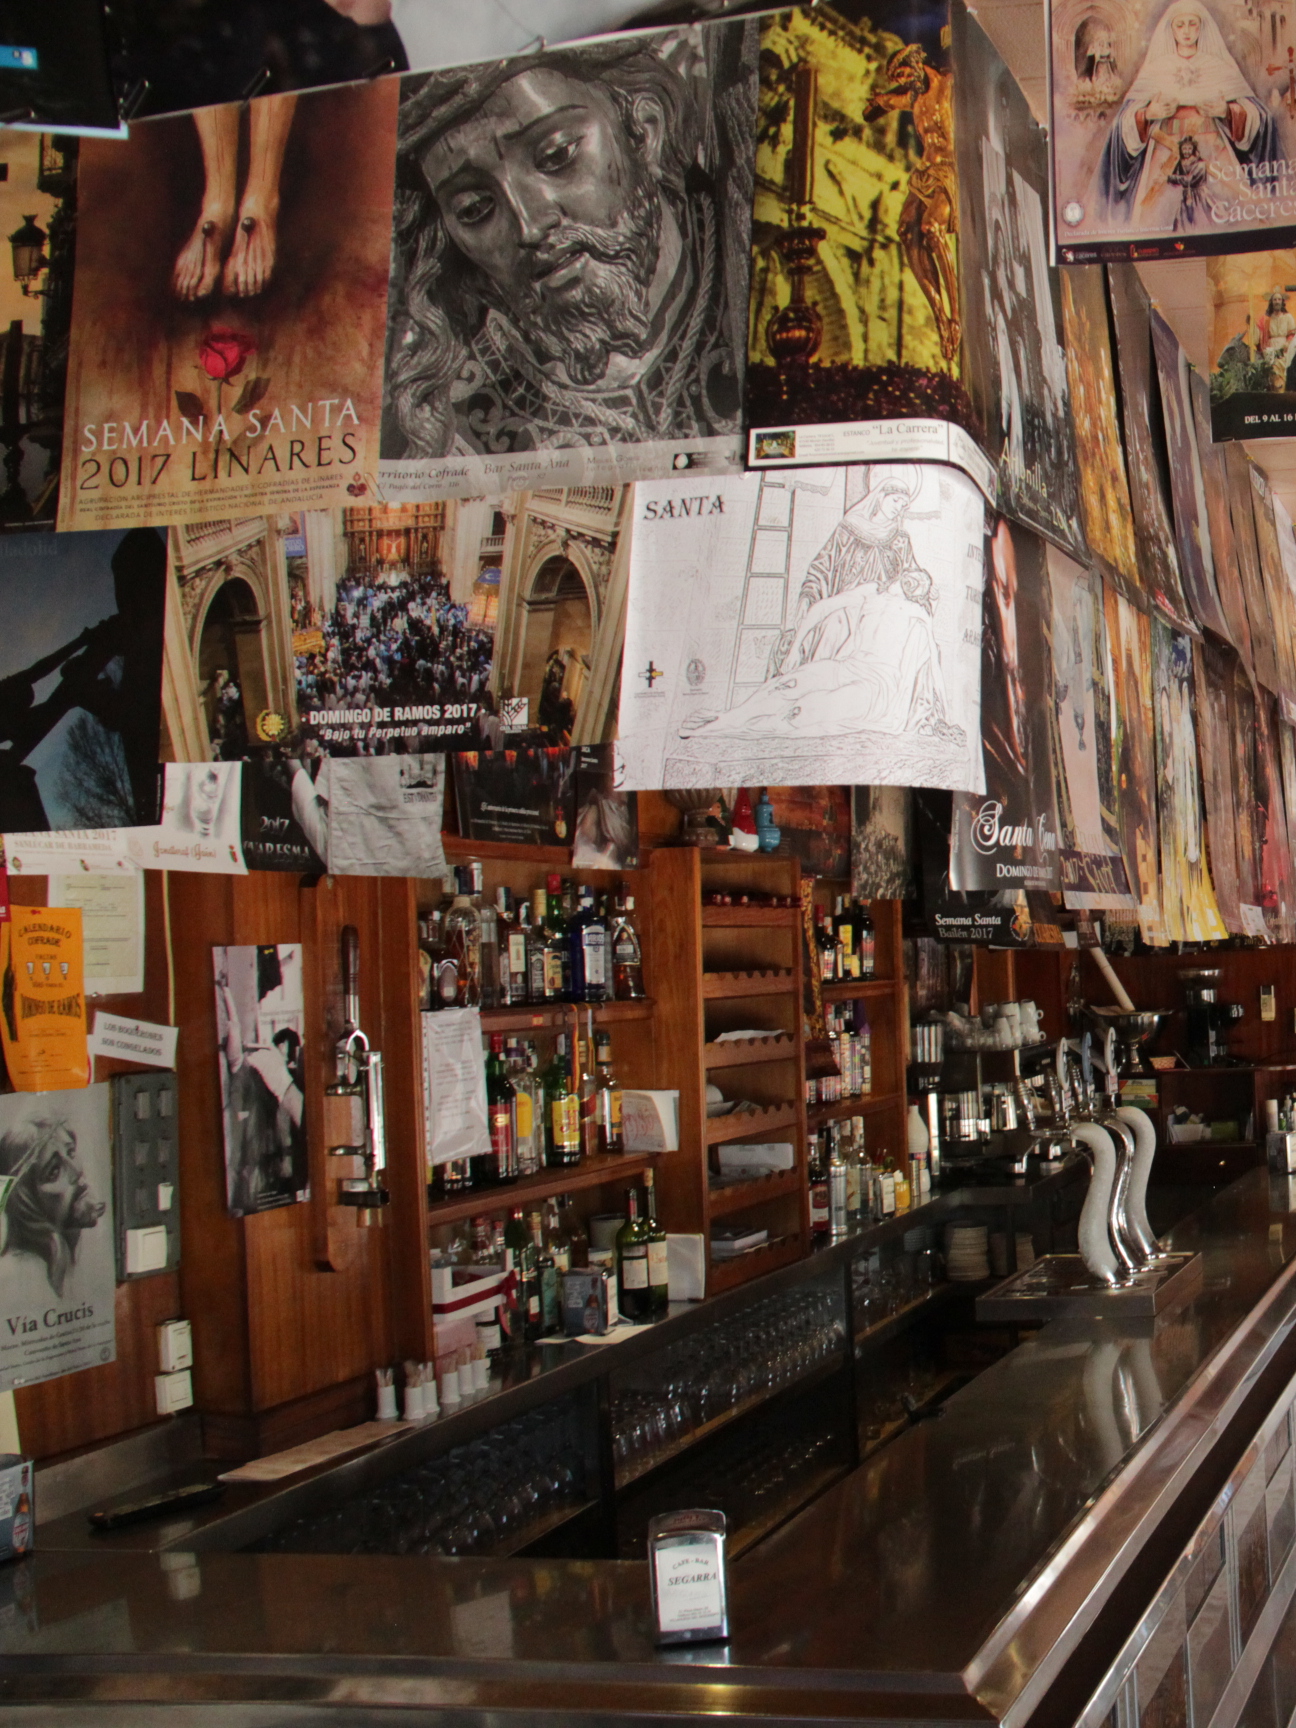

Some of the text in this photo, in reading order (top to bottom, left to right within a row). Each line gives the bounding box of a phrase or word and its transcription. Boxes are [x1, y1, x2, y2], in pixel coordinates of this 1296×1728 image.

[80, 397, 361, 452] SEMANA SANTA
[1244, 415, 1261, 424] DEL
[1269, 414, 1281, 422] AL
[1283, 413, 1294, 421] 16
[843, 429, 870, 437] ESTANCO
[80, 432, 358, 491] 2017 LINARES
[483, 459, 504, 475] Bar
[507, 459, 542, 472] Santa
[544, 455, 570, 470] Ana
[427, 466, 470, 480] Cofrade
[193, 484, 250, 497] HERMANDADES
[257, 477, 299, 490] COFRADÍAS
[301, 477, 311, 486] DE
[312, 473, 344, 485] LINARES
[228, 499, 266, 512] NACIONAL
[280, 492, 324, 505] ANDALUCÍA
[643, 494, 726, 522] SANTA
[309, 704, 477, 725] DOMINGO DE RAMOS 2017
[355, 728, 366, 738] tu
[369, 726, 418, 740] Perpetuo
[92, 829, 117, 841] 2017
[260, 816, 289, 836] 2017
[971, 800, 1034, 855] Santa
[56, 840, 65, 849] DE
[996, 863, 1033, 878] DOMINGO
[935, 913, 1002, 926] Semana Santa
[18, 922, 72, 940] CALENDARIO
[938, 926, 994, 939] Bailén 2017
[27, 936, 61, 948] COFRADE
[48, 1000, 56, 1014] DE
[57, 993, 81, 1019] RAMOS
[104, 1022, 118, 1032] LOS
[116, 1039, 162, 1057] CONGELADOS
[7, 1302, 94, 1336] Vía Crucis
[667, 1571, 718, 1586] SEGARRA
